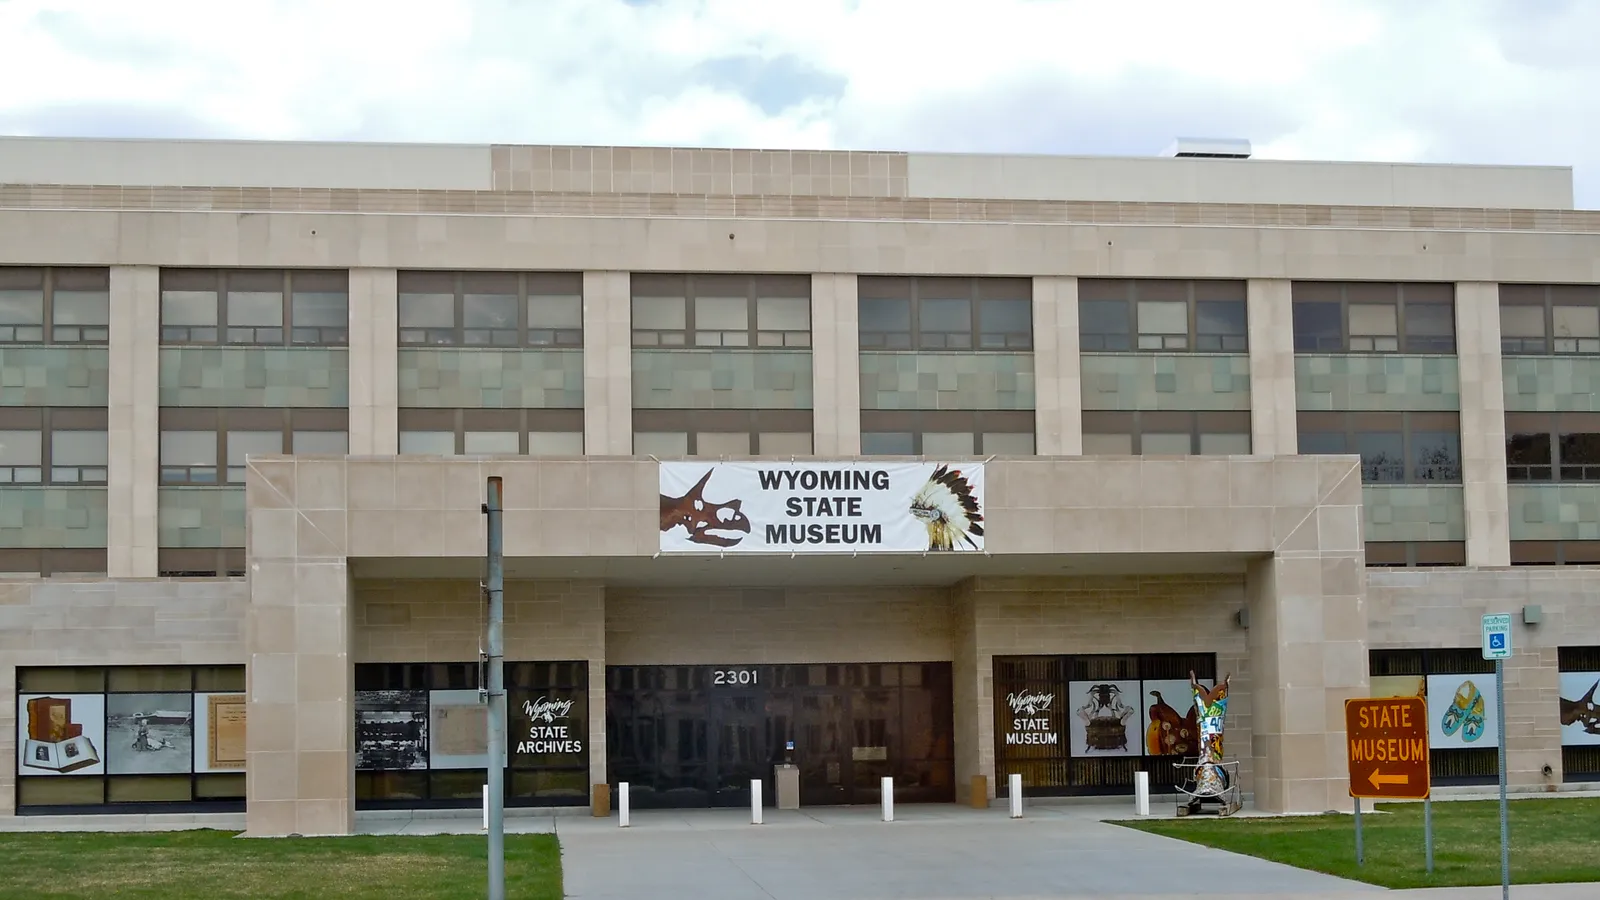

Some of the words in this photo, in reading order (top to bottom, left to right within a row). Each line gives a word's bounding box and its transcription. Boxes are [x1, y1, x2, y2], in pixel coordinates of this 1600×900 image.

[758, 470, 889, 490] WYOMING
[785, 497, 862, 517] STATE
[766, 524, 881, 544] MUSEUM
[1486, 624, 1507, 632] PARKING
[714, 670, 757, 684] 2301
[522, 696, 575, 721] Wyoming
[1006, 689, 1055, 714] Wyoming
[1013, 718, 1050, 730] STATE
[1359, 705, 1412, 728] STATE
[530, 726, 568, 738] STATE
[1006, 732, 1057, 745] MUSEUM
[516, 741, 582, 753] ARCHIVES
[1351, 739, 1424, 761] MUSEUM
